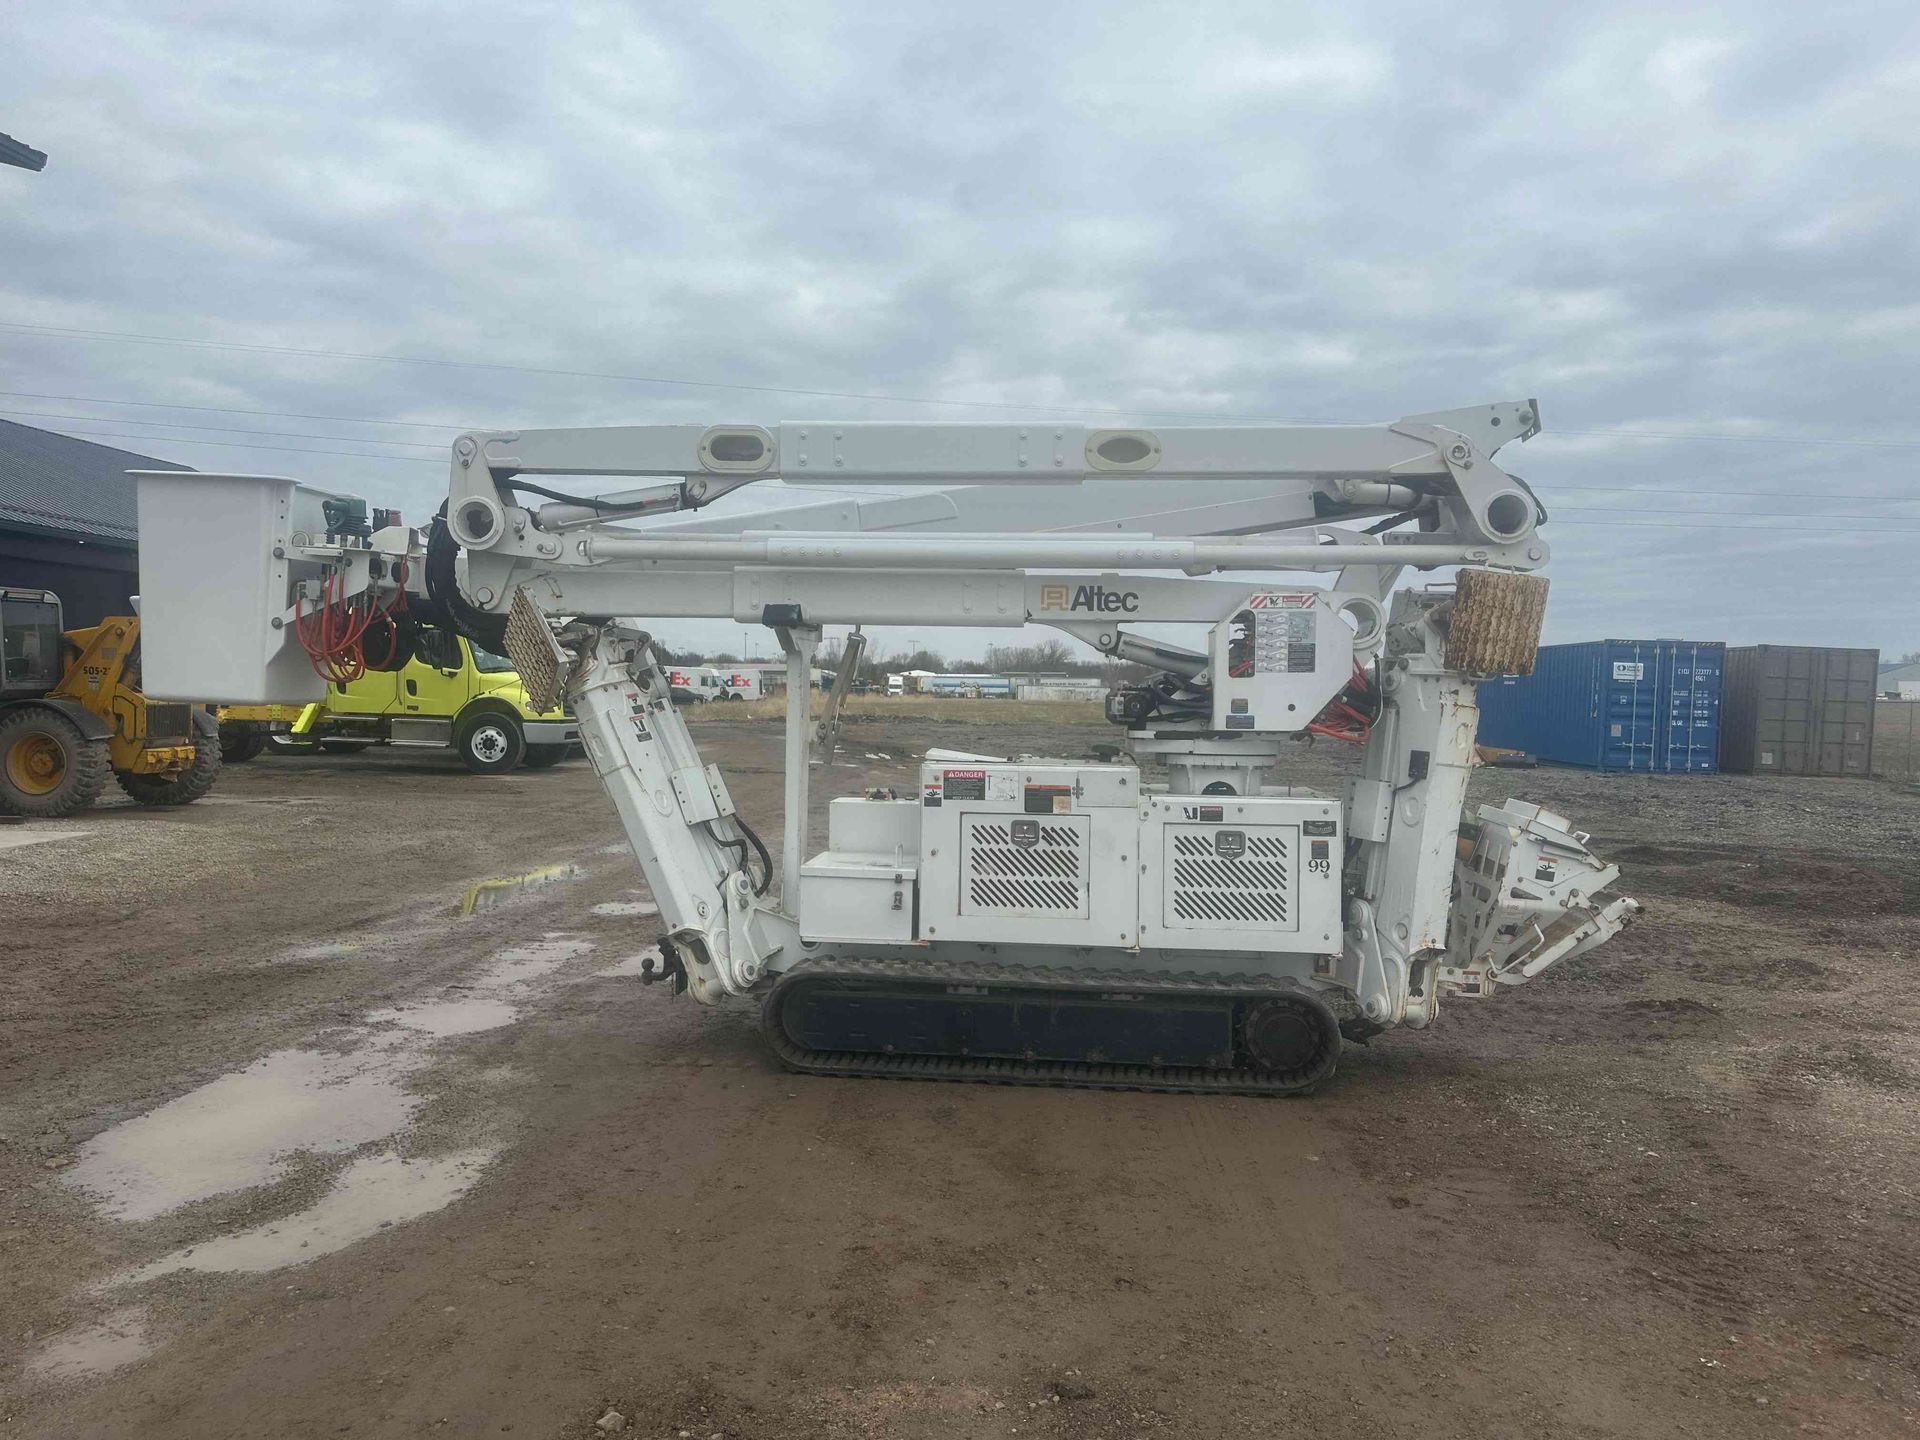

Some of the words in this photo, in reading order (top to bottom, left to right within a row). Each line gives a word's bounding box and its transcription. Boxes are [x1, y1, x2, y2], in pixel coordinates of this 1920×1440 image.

[1070, 585, 1139, 612] Altec
[83, 666, 112, 675] 505-2
[665, 671, 691, 687] dEx
[725, 674, 751, 688] dEx
[955, 771, 983, 779] DANGER
[1308, 860, 1330, 873] 99
